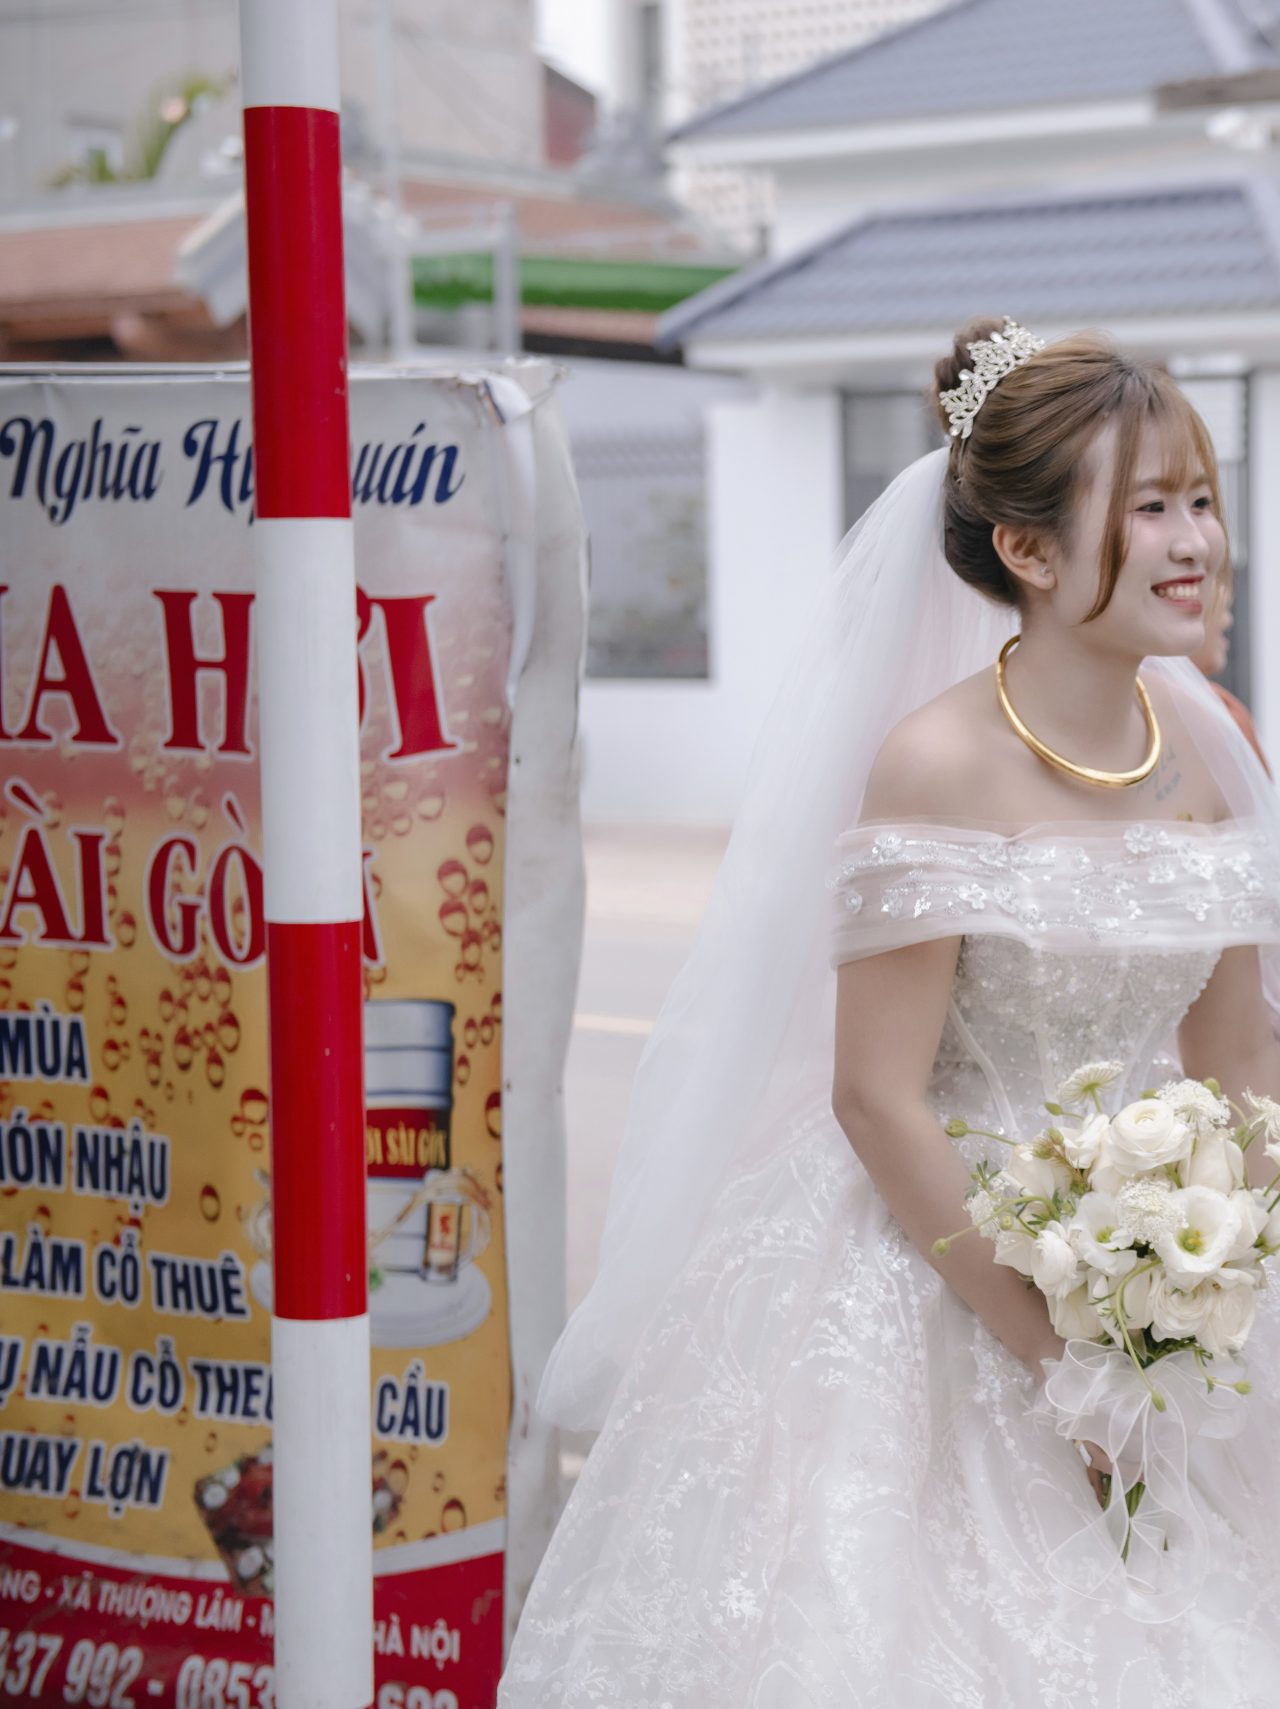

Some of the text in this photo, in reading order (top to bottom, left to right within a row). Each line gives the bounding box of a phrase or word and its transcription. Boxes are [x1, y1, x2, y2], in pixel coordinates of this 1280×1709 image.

[0, 416, 164, 526] Nghĩa
[350, 422, 466, 508] uán
[0, 583, 457, 759] A HI
[148, 798, 380, 964] GÒ
[0, 1003, 88, 1080] MÙA
[0, 1112, 168, 1212] ÓN NHẬU
[1, 1228, 83, 1295] LÀM
[151, 1255, 247, 1316] THUÊ
[192, 1362, 273, 1422] THE
[376, 1363, 445, 1440] CẦU
[86, 1444, 166, 1514] LỢN
[0, 1568, 42, 1603] NG
[410, 1617, 461, 1671] NỘI
[0, 1627, 64, 1699] 37
[63, 1637, 146, 1709] 992
